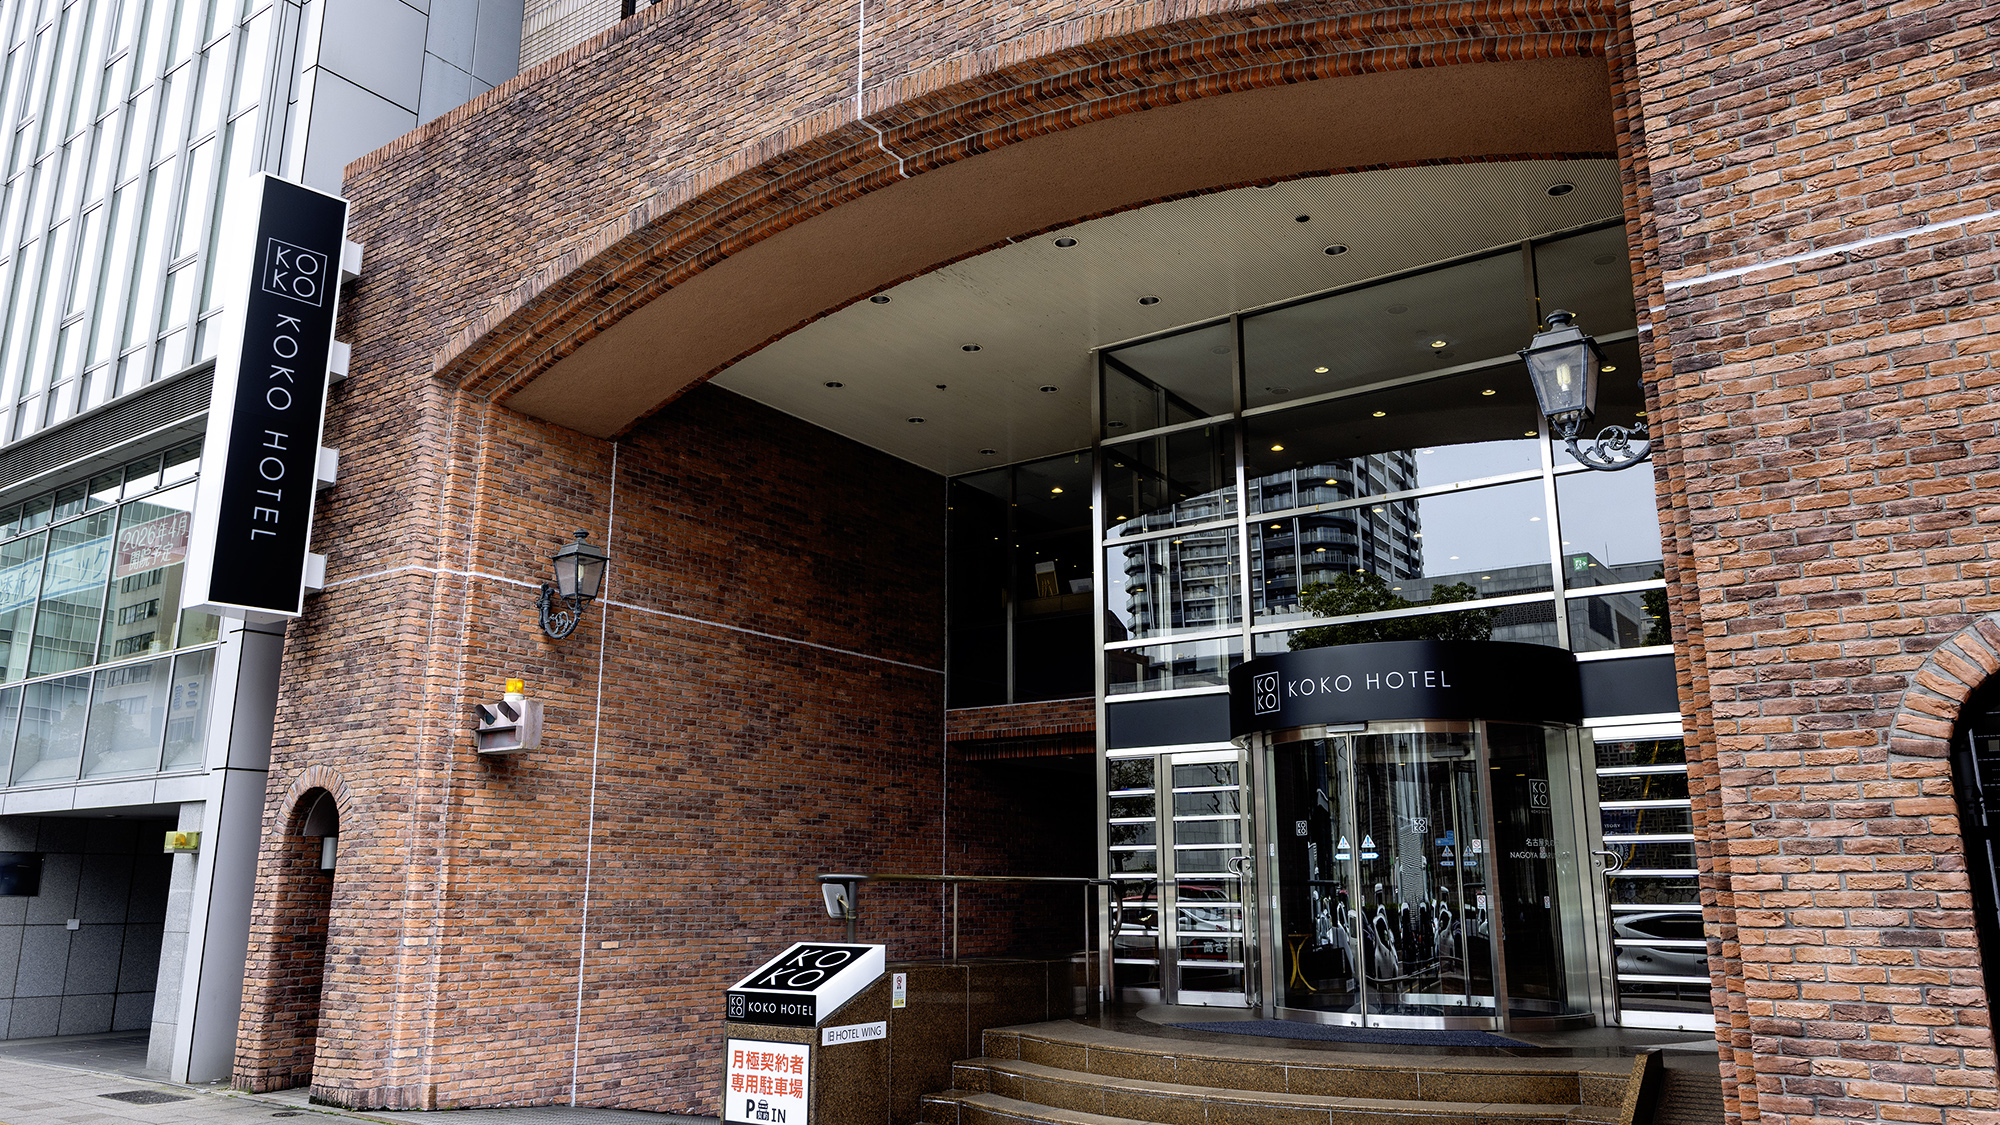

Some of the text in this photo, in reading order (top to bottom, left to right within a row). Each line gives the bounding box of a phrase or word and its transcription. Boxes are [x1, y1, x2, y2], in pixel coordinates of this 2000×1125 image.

[274, 245, 319, 275] KO
[272, 269, 316, 298] KO
[251, 313, 302, 541] KOKO HOTEL
[122, 515, 190, 552] 2026年4月
[1256, 676, 1276, 694] KO
[1288, 670, 1451, 698] KOKO HOTEL
[1257, 693, 1277, 711] KO
[1532, 782, 1547, 794] KO
[1533, 794, 1548, 806] KO
[1525, 838, 1561, 847] 名古屋丸の
[1510, 851, 1539, 859] NAGOYA
[1203, 941, 1228, 954] 高さ
[786, 949, 851, 968] KO
[757, 967, 825, 987] KO
[731, 996, 743, 1006] KO
[748, 1001, 814, 1016] KOKO HOTEL
[731, 1006, 743, 1016] KO
[861, 1025, 882, 1038] WING
[732, 1050, 804, 1075] 月極契約者
[731, 1073, 803, 1099] 専用駐車場
[746, 1099, 756, 1118] P
[771, 1108, 786, 1123] IN
